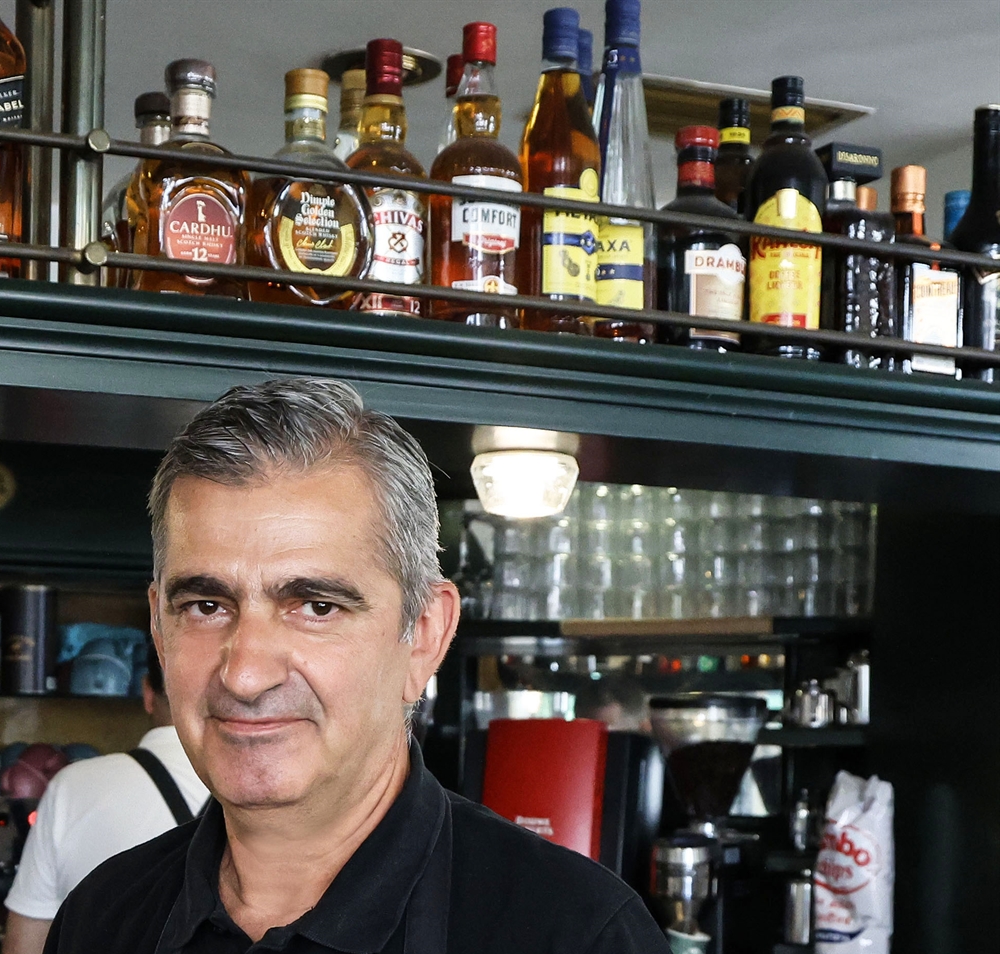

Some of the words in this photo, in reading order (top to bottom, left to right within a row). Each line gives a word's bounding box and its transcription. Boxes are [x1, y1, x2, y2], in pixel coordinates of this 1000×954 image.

[300, 191, 336, 208] Dimple
[300, 203, 335, 218] Golden
[462, 206, 518, 229] COMFORT
[169, 220, 232, 238] CARDHU
[294, 213, 340, 229] Selection
[370, 210, 423, 234] CHIVAS
[191, 247, 208, 262] 12
[360, 294, 383, 310] XII
[409, 299, 421, 315] 12
